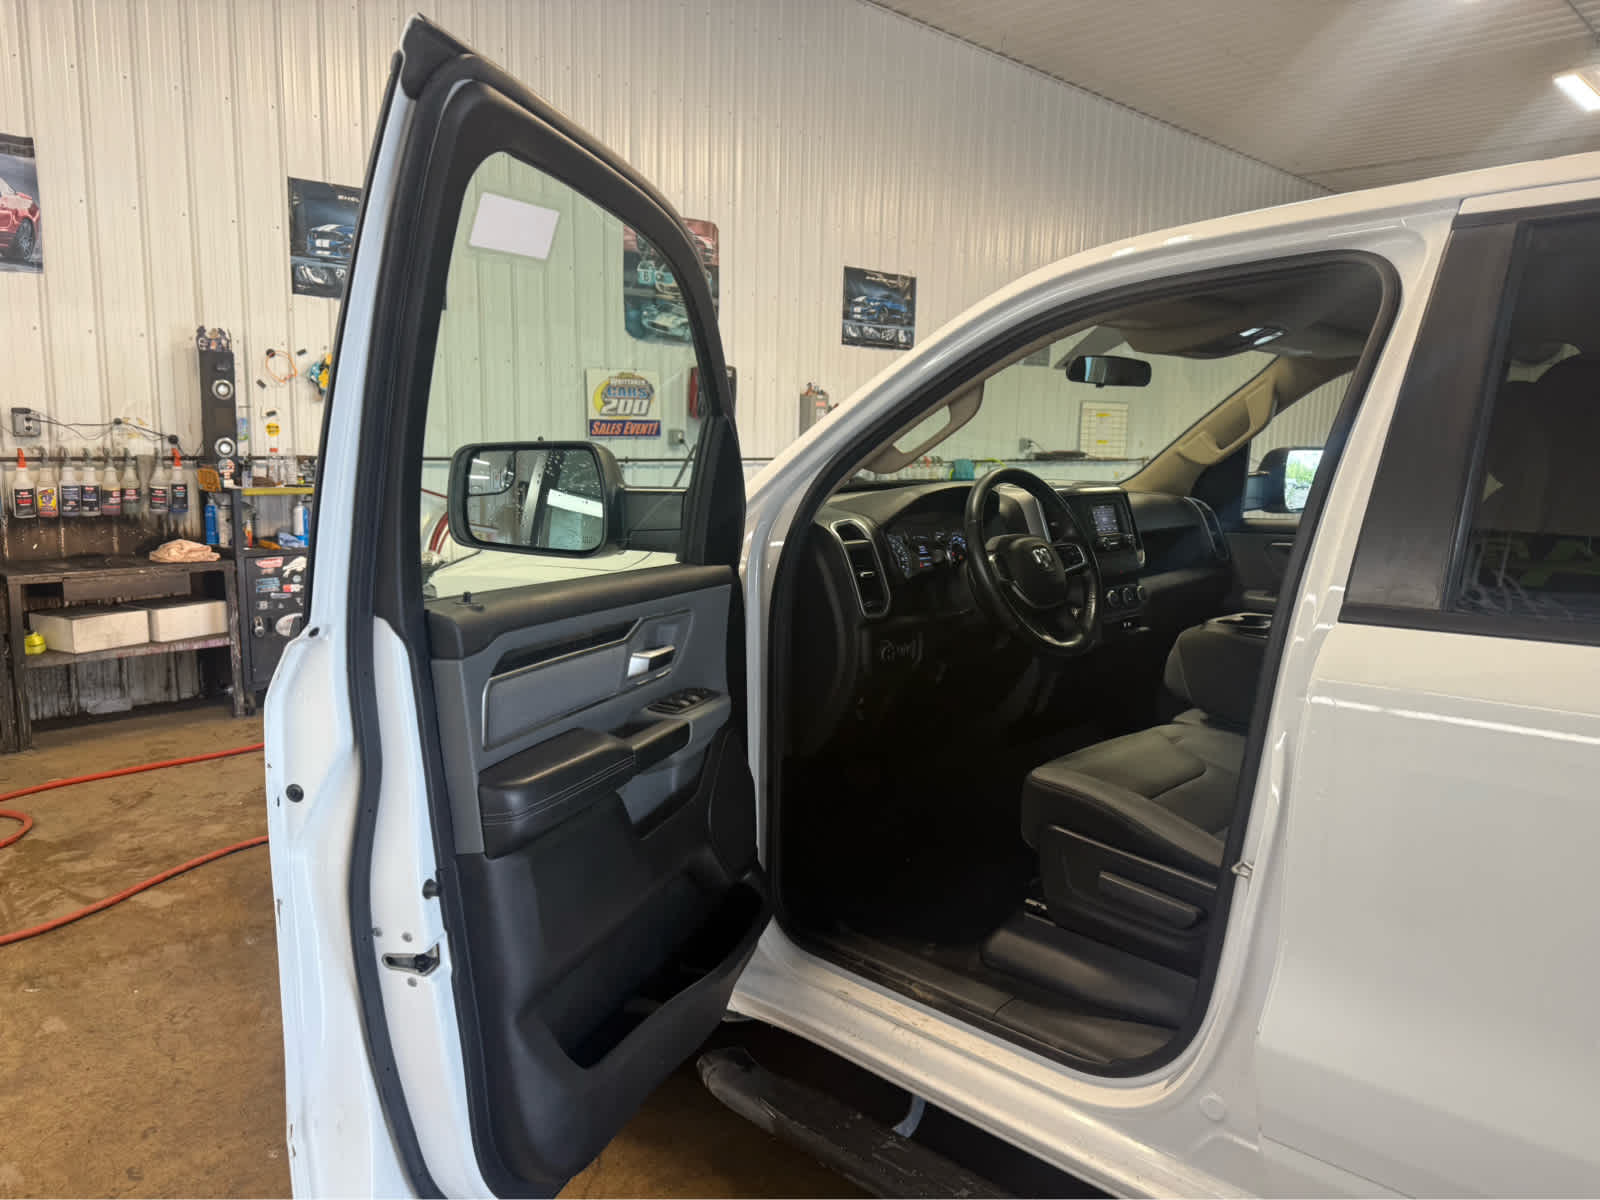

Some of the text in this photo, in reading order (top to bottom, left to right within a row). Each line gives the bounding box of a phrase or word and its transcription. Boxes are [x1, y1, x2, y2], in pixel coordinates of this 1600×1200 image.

[605, 386, 649, 399] CARS
[600, 399, 650, 416] 200
[592, 421, 623, 435] SALES
